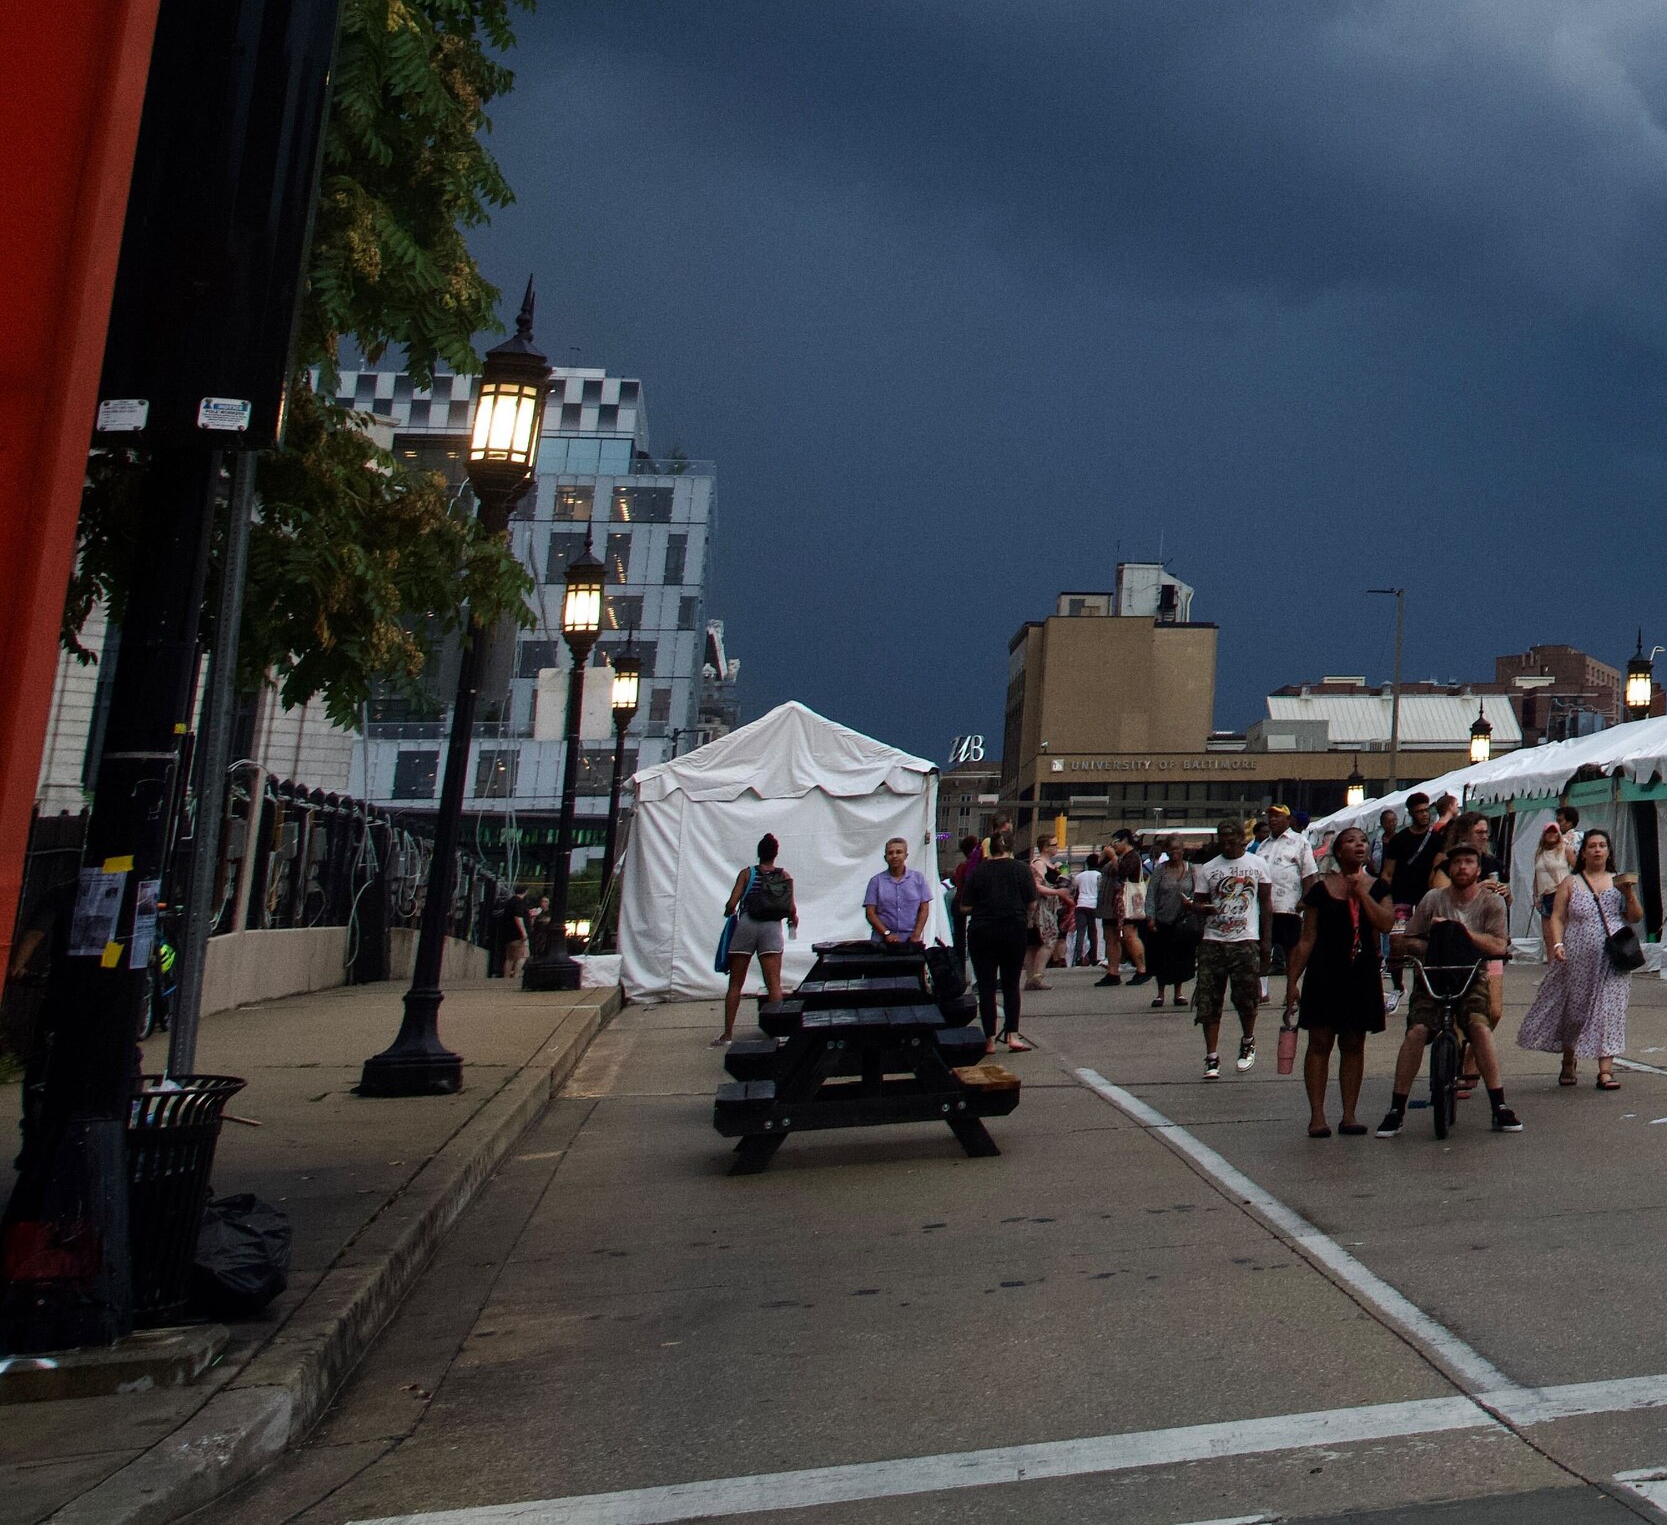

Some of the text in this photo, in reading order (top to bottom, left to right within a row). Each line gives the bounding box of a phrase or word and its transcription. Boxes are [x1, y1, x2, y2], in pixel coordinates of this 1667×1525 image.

[948, 734, 985, 763] UB
[1071, 759, 1257, 771] UNIVERSITY OF BALTIMORE
